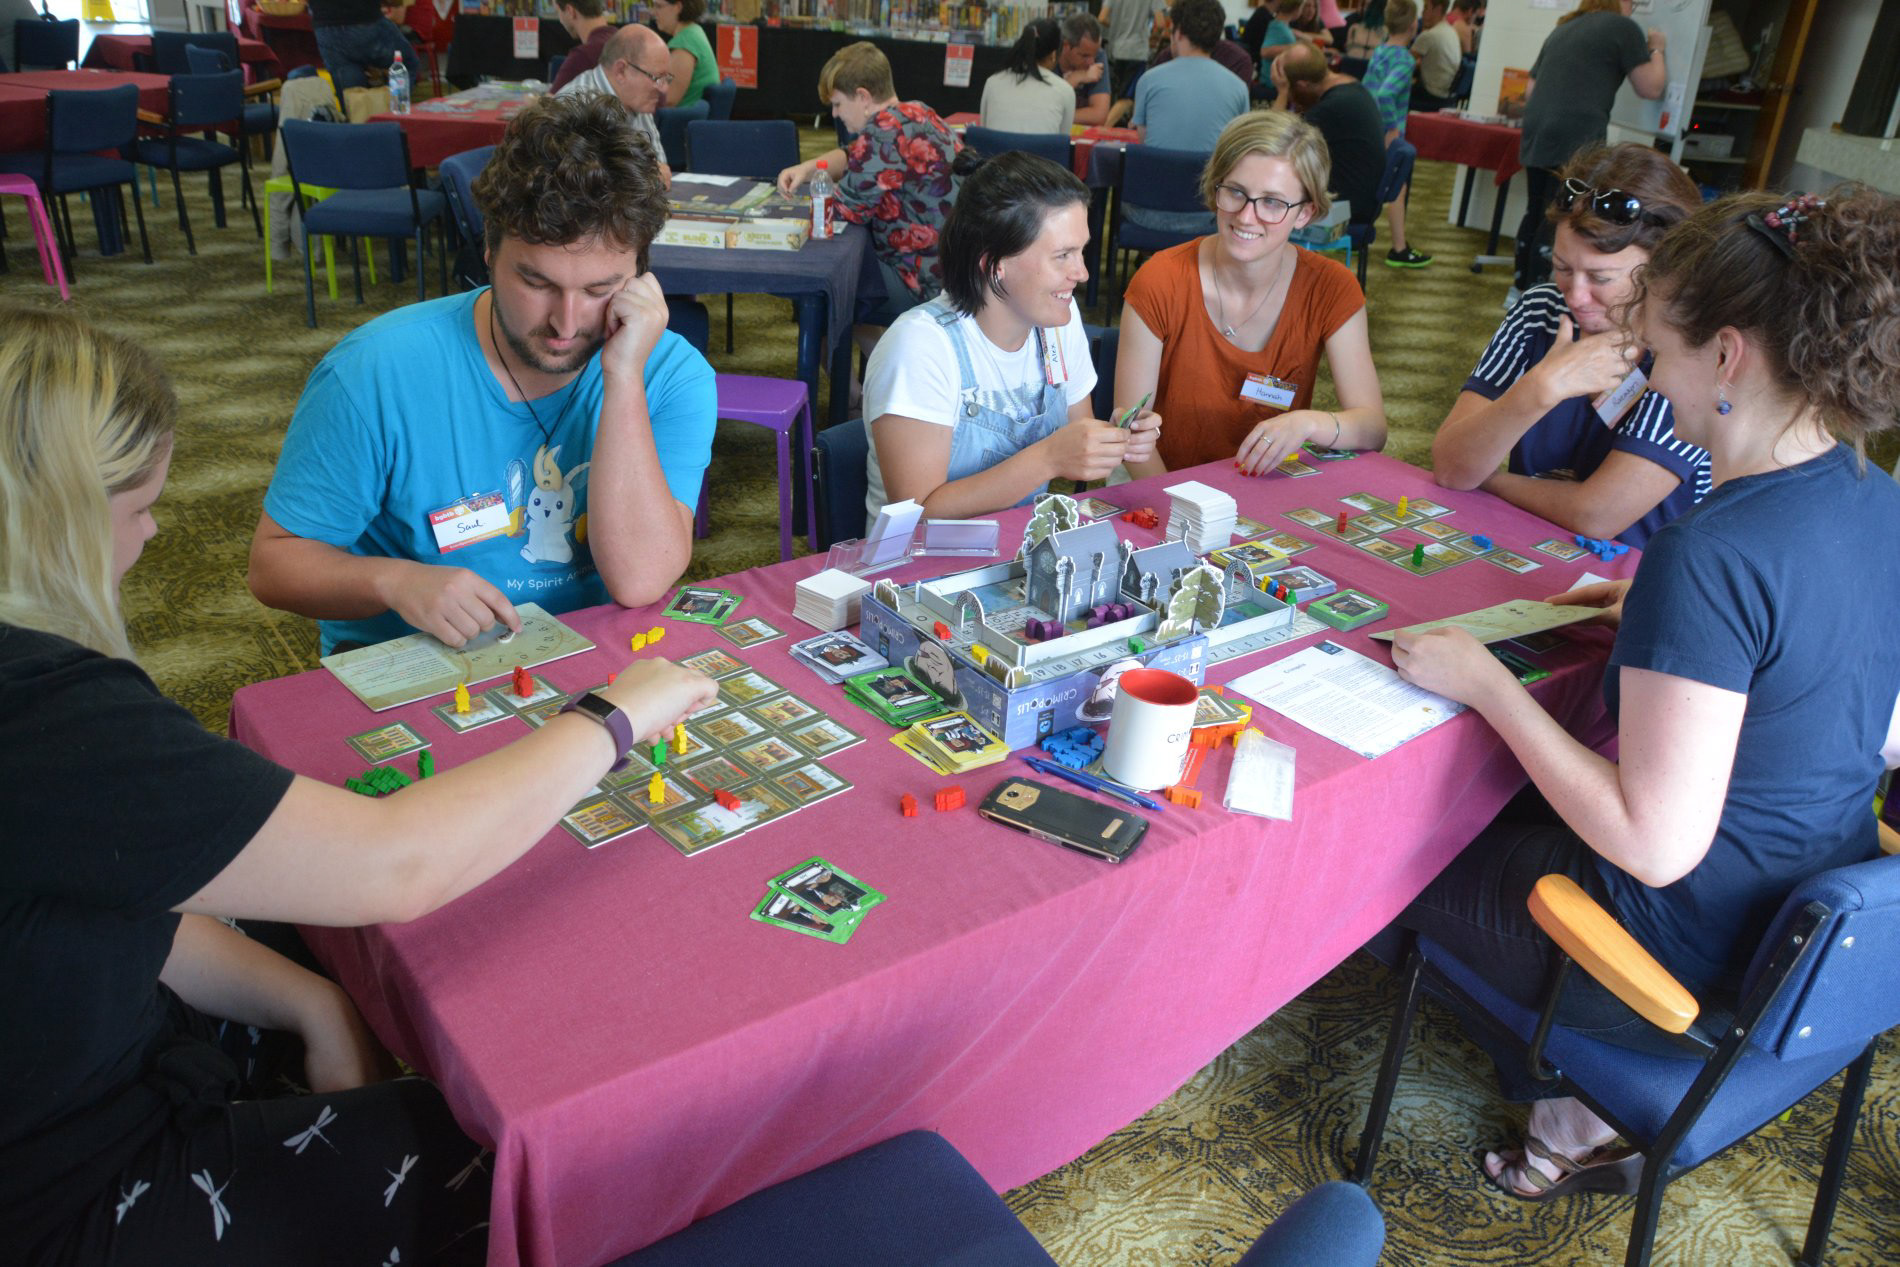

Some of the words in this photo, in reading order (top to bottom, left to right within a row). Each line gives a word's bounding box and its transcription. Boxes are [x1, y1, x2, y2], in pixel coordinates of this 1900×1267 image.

[1256, 387, 1282, 401] Hannah
[457, 519, 483, 533] Saul
[507, 579, 524, 591] My
[528, 577, 563, 590] Spirit
[865, 610, 905, 645] CRIMOPOLIS
[1034, 669, 1046, 678] 19
[1052, 664, 1067, 672] 18
[1071, 658, 1083, 666] 17
[1093, 652, 1107, 660] 16
[1016, 688, 1078, 716] CRIMOPOLIS
